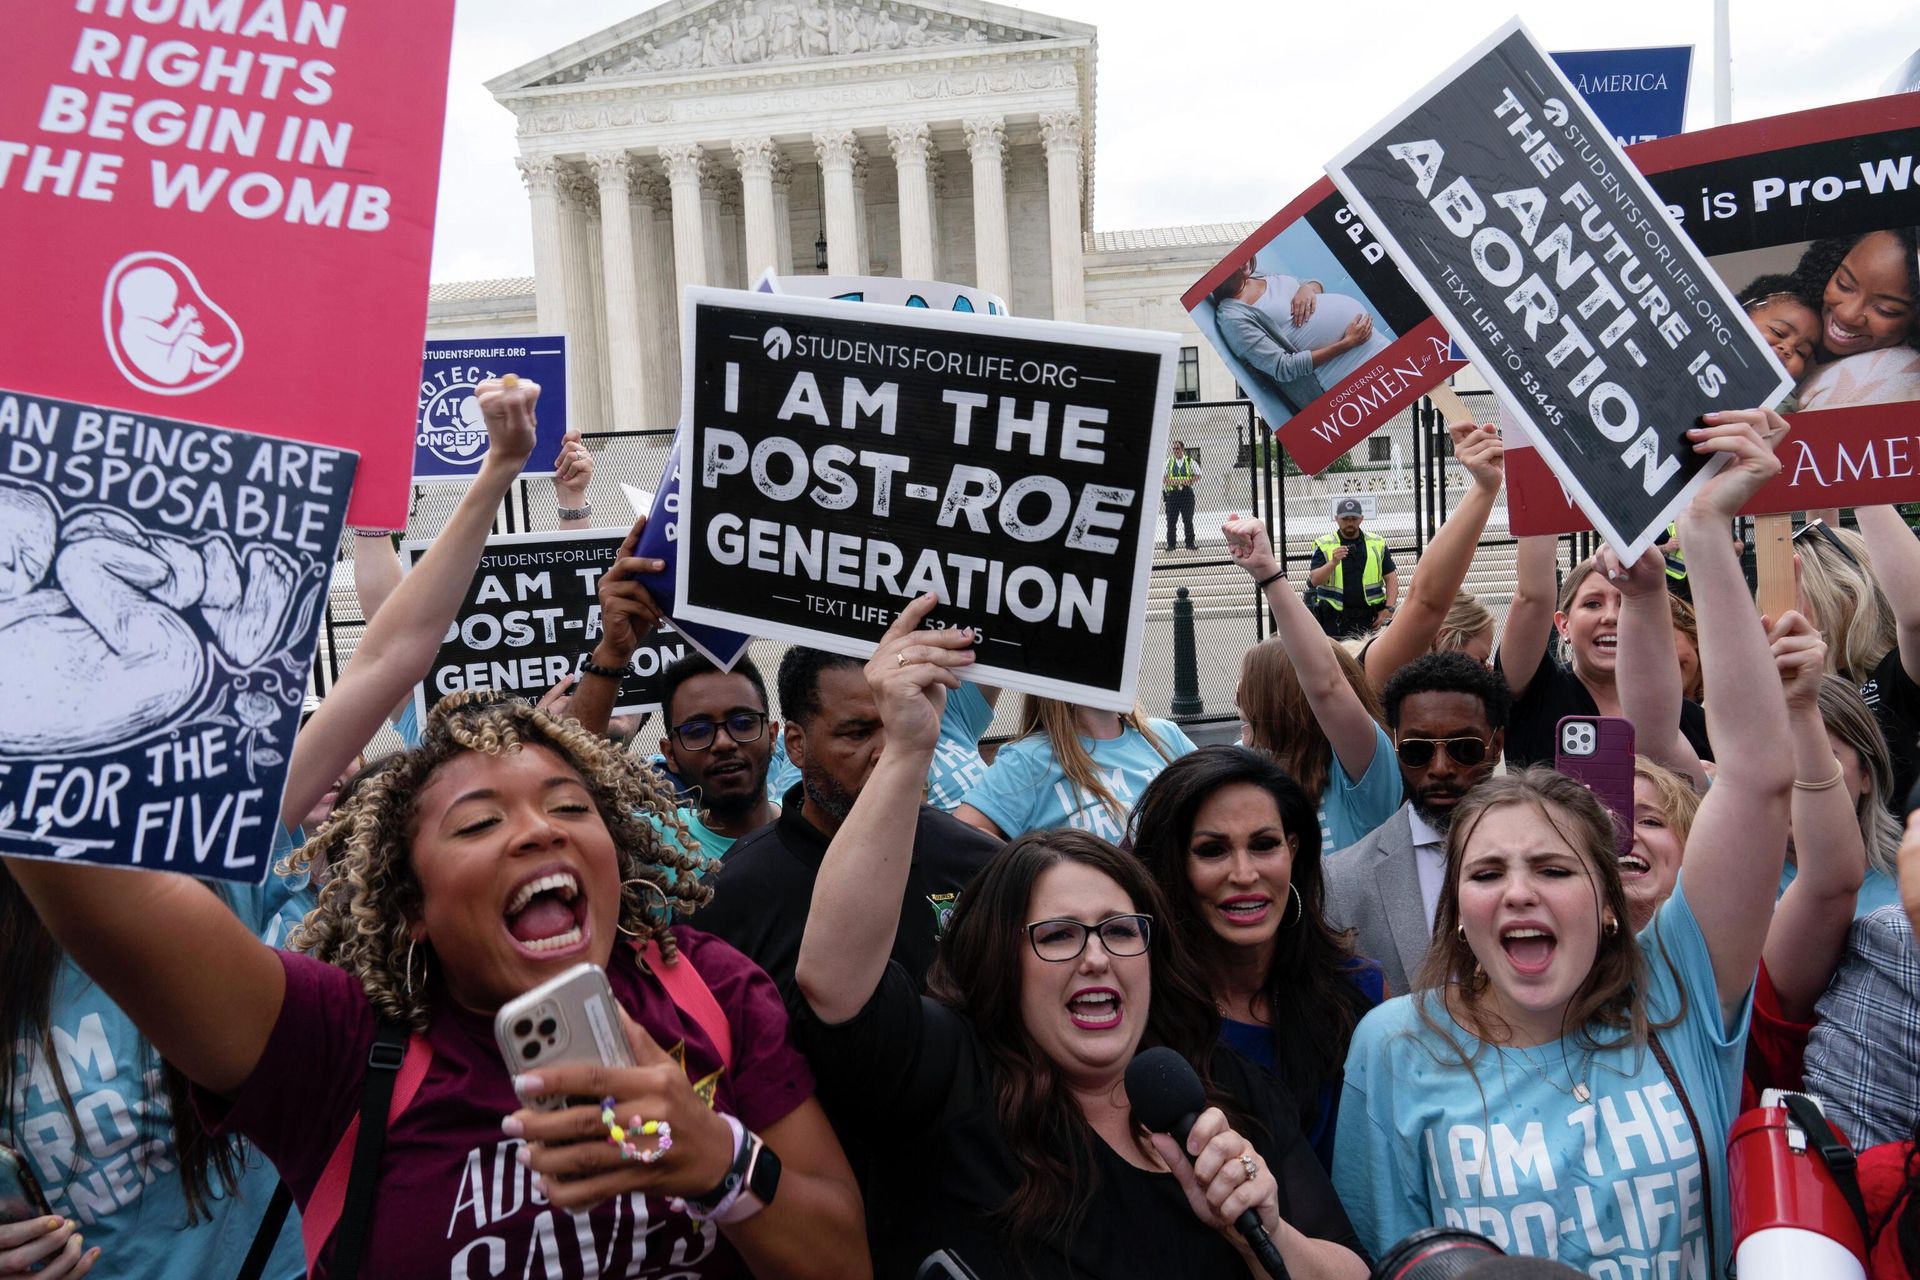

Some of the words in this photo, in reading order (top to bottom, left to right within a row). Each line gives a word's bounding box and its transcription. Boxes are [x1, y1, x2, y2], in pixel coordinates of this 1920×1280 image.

[71, 28, 336, 105] RIGHTS
[1577, 73, 1668, 94] AMERICA
[39, 85, 264, 157] BEGIN
[276, 116, 353, 168] IN
[151, 159, 391, 231] WOMB
[1701, 187, 1738, 221] is
[1753, 155, 1920, 213] Pro-W
[1492, 186, 1648, 368] ANTI-
[1493, 87, 1565, 179] THE
[1559, 181, 1691, 350] FUTURE
[1687, 352, 1727, 399] IS
[1563, 125, 1732, 347] STUDENTSFORLIFE.ORG
[1386, 138, 1682, 497] ABORTION
[1440, 264, 1476, 306] TEXT
[1471, 307, 1504, 347] LIFE
[1501, 344, 1522, 370] TO
[1520, 371, 1564, 426] 53445
[795, 335, 1078, 389] STUDENTSFORLIFE.ORG
[1310, 356, 1424, 444] WOMEN
[1330, 365, 1385, 408] CONCERNED
[435, 397, 461, 416] AT
[725, 361, 740, 413] I
[777, 371, 900, 436] AM
[942, 389, 1110, 465] THE
[9, 440, 330, 552] DISPOSABLE
[72, 410, 233, 475] BEINGS
[246, 449, 340, 496] ARE
[703, 427, 1136, 555] POST-ROE
[475, 571, 552, 605] AM
[481, 547, 622, 568] STUDENTSFORLIFE.
[706, 512, 1109, 634] GENERATION
[805, 594, 848, 618] TEXT
[852, 603, 888, 626] LIFE
[21, 763, 131, 828] FOR
[145, 727, 228, 787] THE
[131, 789, 264, 868] FIVE
[1424, 1128, 1447, 1199] I
[1447, 1121, 1557, 1199] AM
[1567, 1081, 1697, 1177] THE
